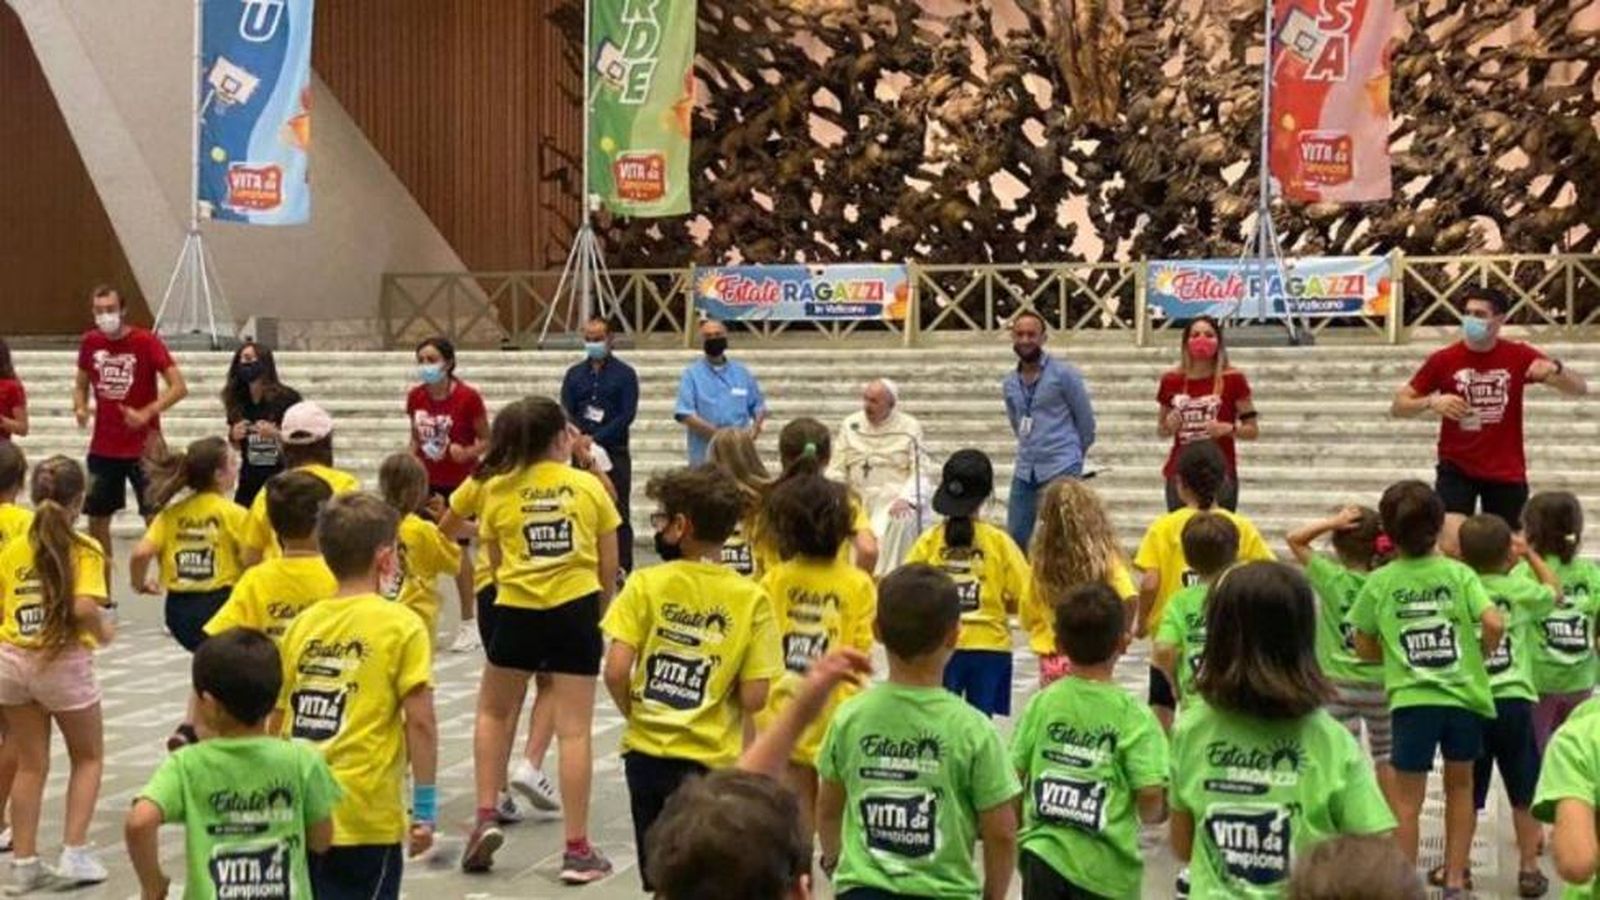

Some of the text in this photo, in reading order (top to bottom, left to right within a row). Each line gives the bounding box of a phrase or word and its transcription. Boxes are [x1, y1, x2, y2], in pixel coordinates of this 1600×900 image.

[1301, 142, 1332, 161] VITA
[231, 171, 261, 189] VITA
[618, 162, 645, 180] VITA
[783, 282, 884, 301] RAGAZZI
[529, 525, 556, 541] VITA
[1405, 632, 1437, 650] VITA
[655, 658, 688, 685] VITA
[298, 694, 330, 717] VITA
[1206, 741, 1268, 770] Estate
[1042, 781, 1081, 808] VITA
[866, 803, 930, 829] VITA da
[1212, 820, 1283, 851] VITA da
[216, 857, 283, 882] VITA da
